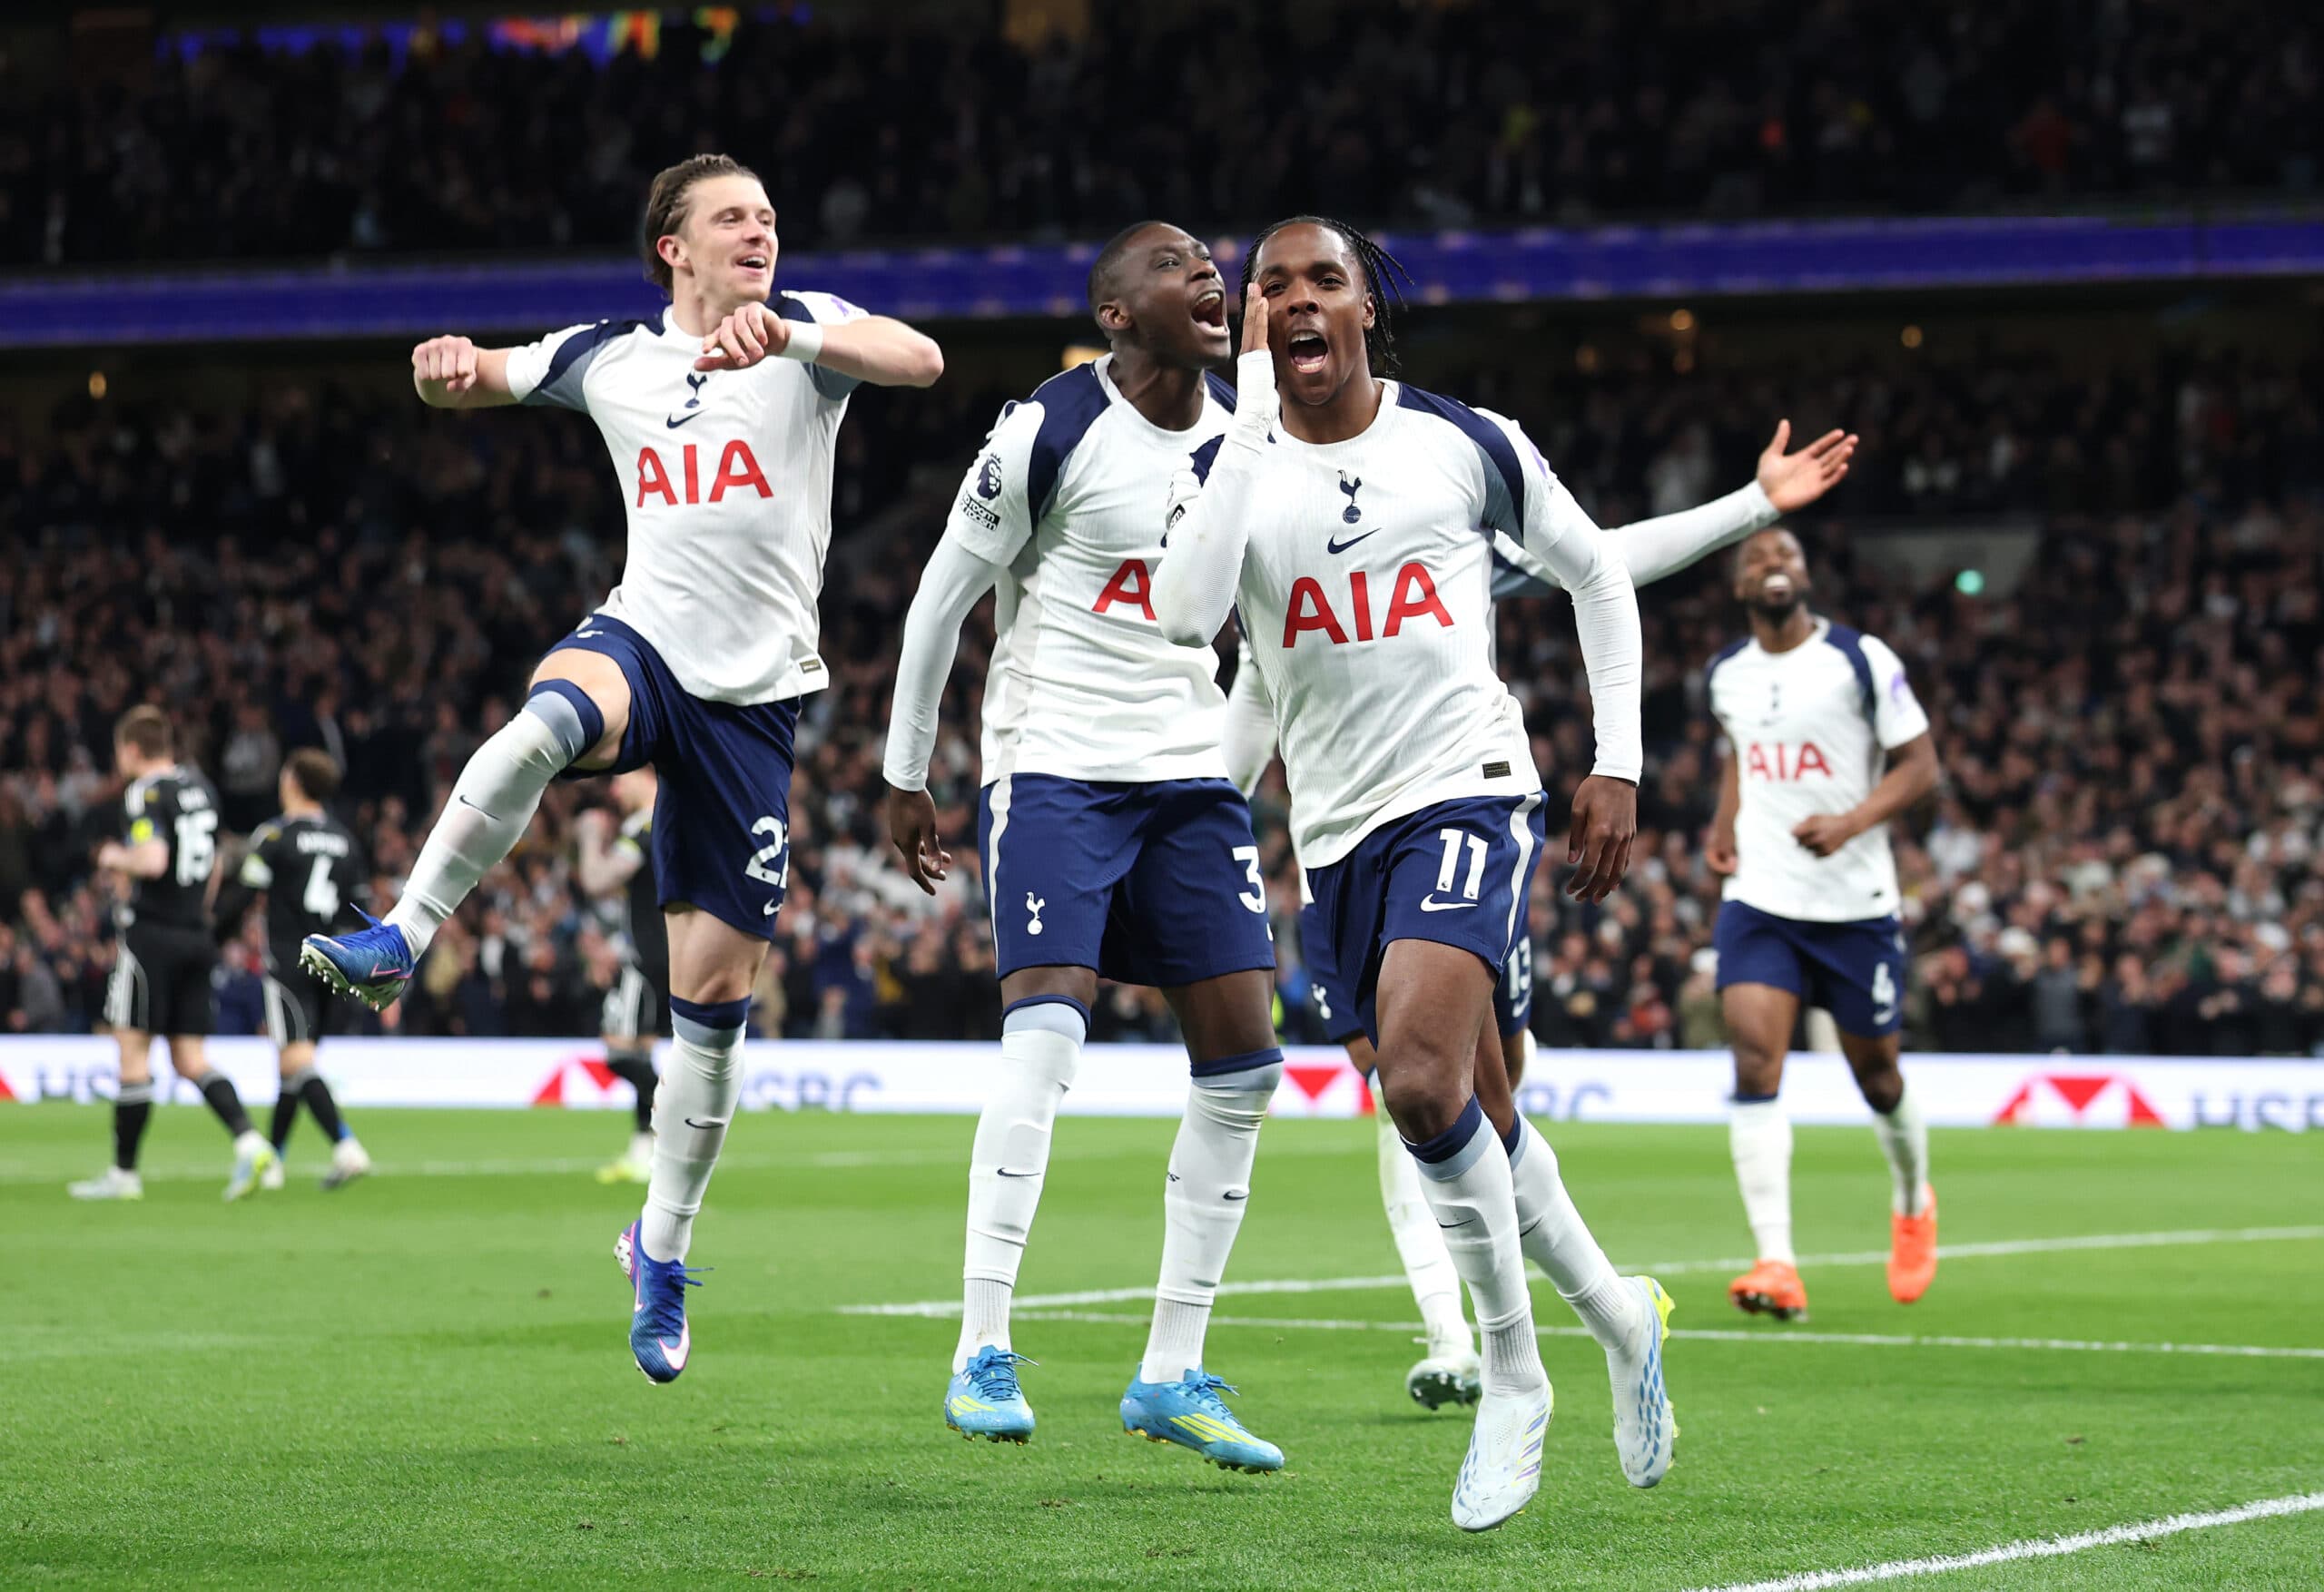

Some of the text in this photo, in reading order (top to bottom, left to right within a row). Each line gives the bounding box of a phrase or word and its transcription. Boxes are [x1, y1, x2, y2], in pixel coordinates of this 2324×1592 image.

[636, 439, 774, 508] AIA
[969, 500, 997, 524] room
[1283, 562, 1454, 648] AIA
[1748, 742, 1833, 781] AIA
[303, 854, 340, 924] 4
[1436, 829, 1489, 900] 11
[1507, 936, 1532, 1000] 13
